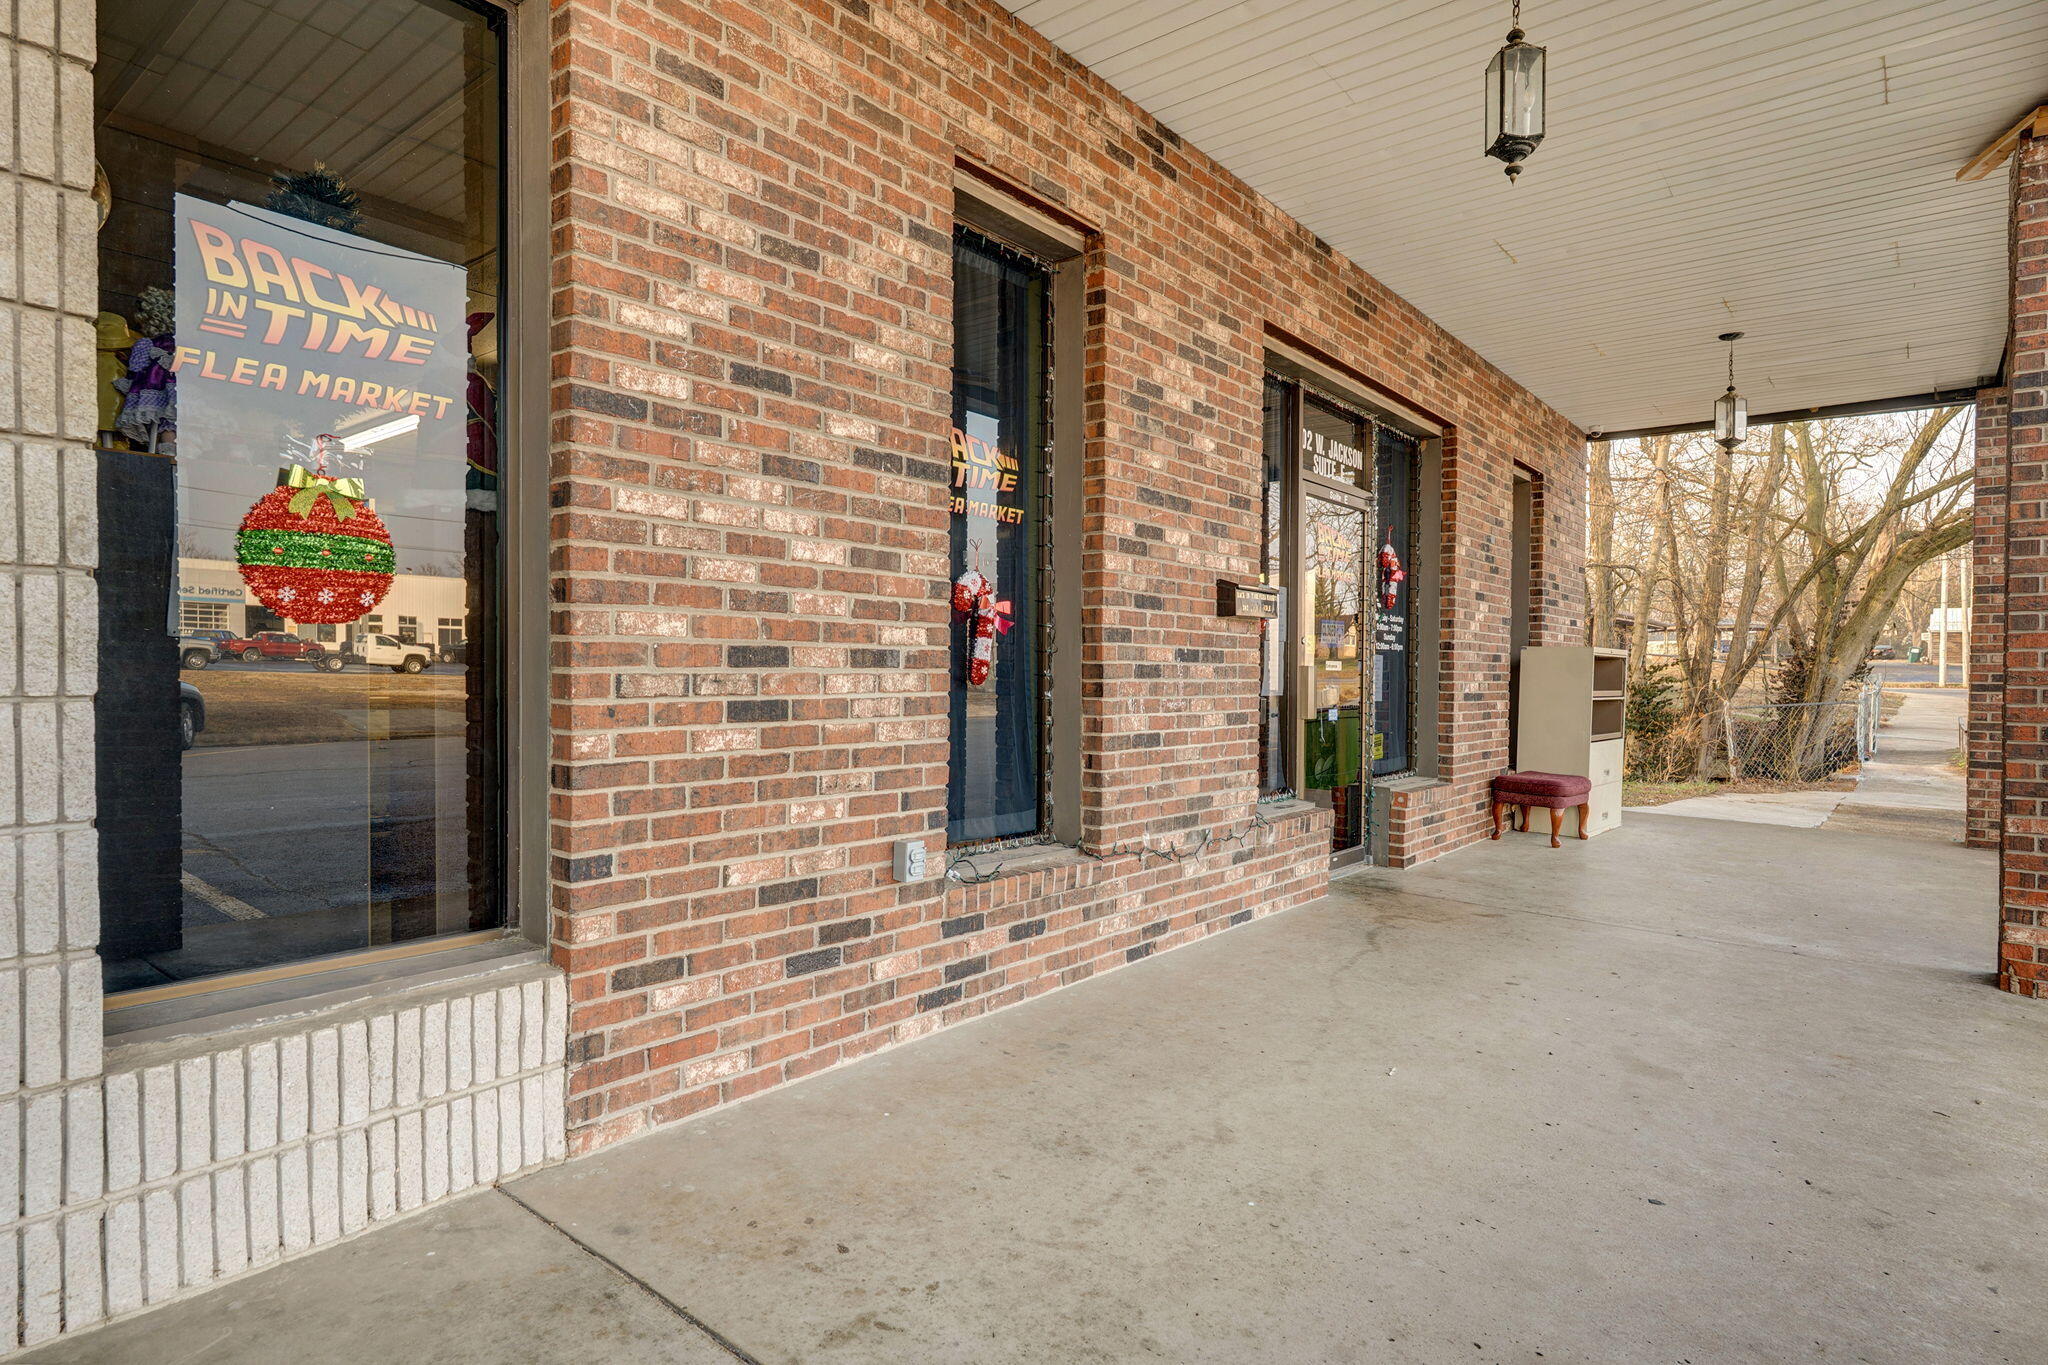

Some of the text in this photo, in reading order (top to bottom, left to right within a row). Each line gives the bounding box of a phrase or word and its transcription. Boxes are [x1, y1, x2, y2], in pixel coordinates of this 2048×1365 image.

[190, 219, 397, 328] BACK
[207, 288, 247, 320] IN
[254, 298, 437, 366] TIME
[170, 346, 454, 420] FLEA MARKET
[951, 427, 1003, 470] ACK
[1302, 429, 1363, 470] 02 W. JACKSON
[1313, 454, 1337, 480] SUITE
[952, 461, 1018, 492] TIME
[948, 496, 1024, 524] EA MARKET
